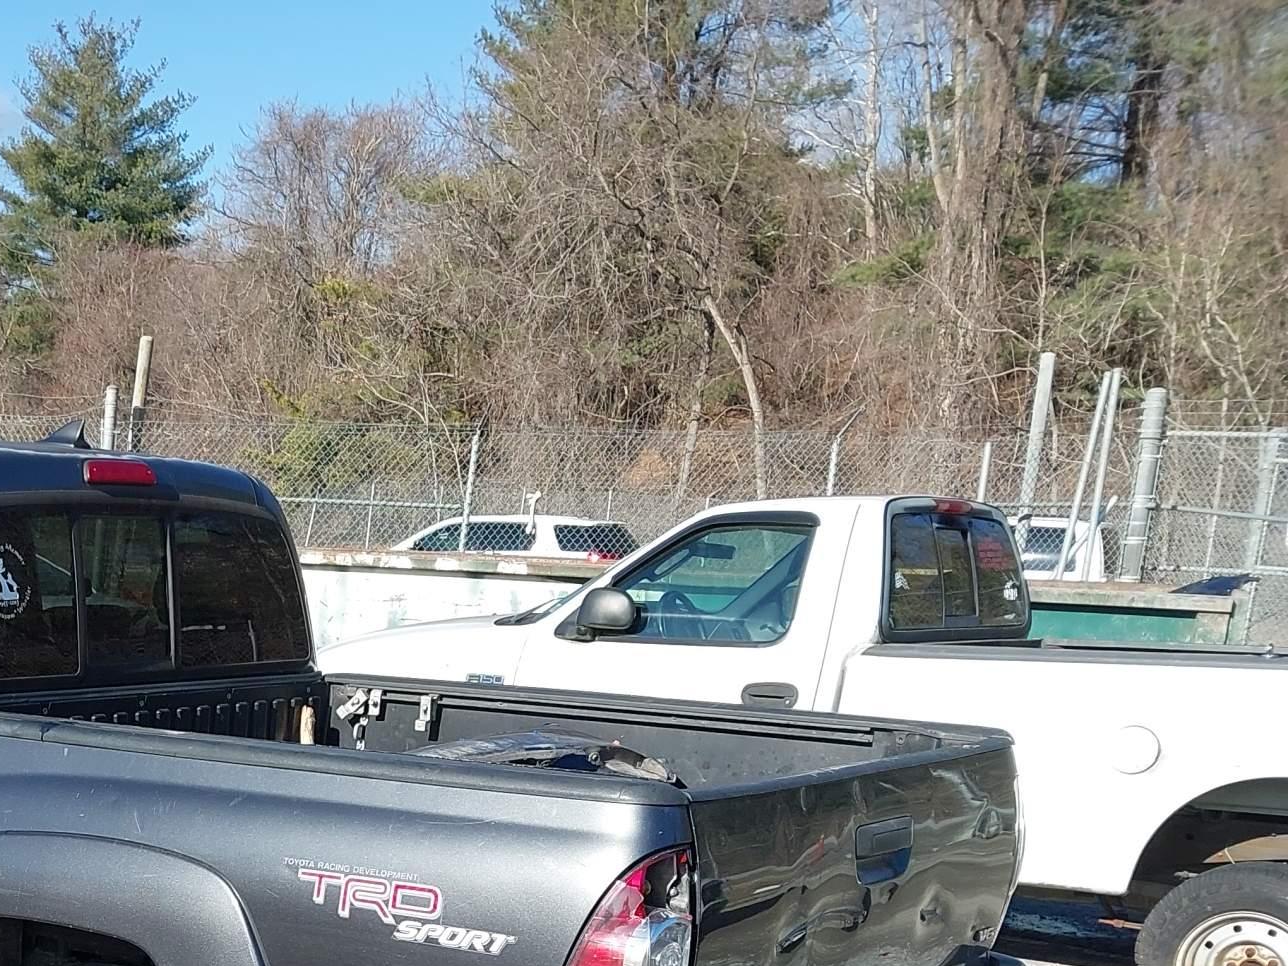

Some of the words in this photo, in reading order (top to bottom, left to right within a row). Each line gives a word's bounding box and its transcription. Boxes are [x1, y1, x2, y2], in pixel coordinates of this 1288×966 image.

[283, 857, 315, 868] TOYOTA
[317, 861, 350, 873] RACING
[353, 866, 419, 882] DEVELOPMENT
[298, 868, 442, 926] TRD
[392, 920, 518, 956] SPORT
[979, 927, 995, 942] V6
